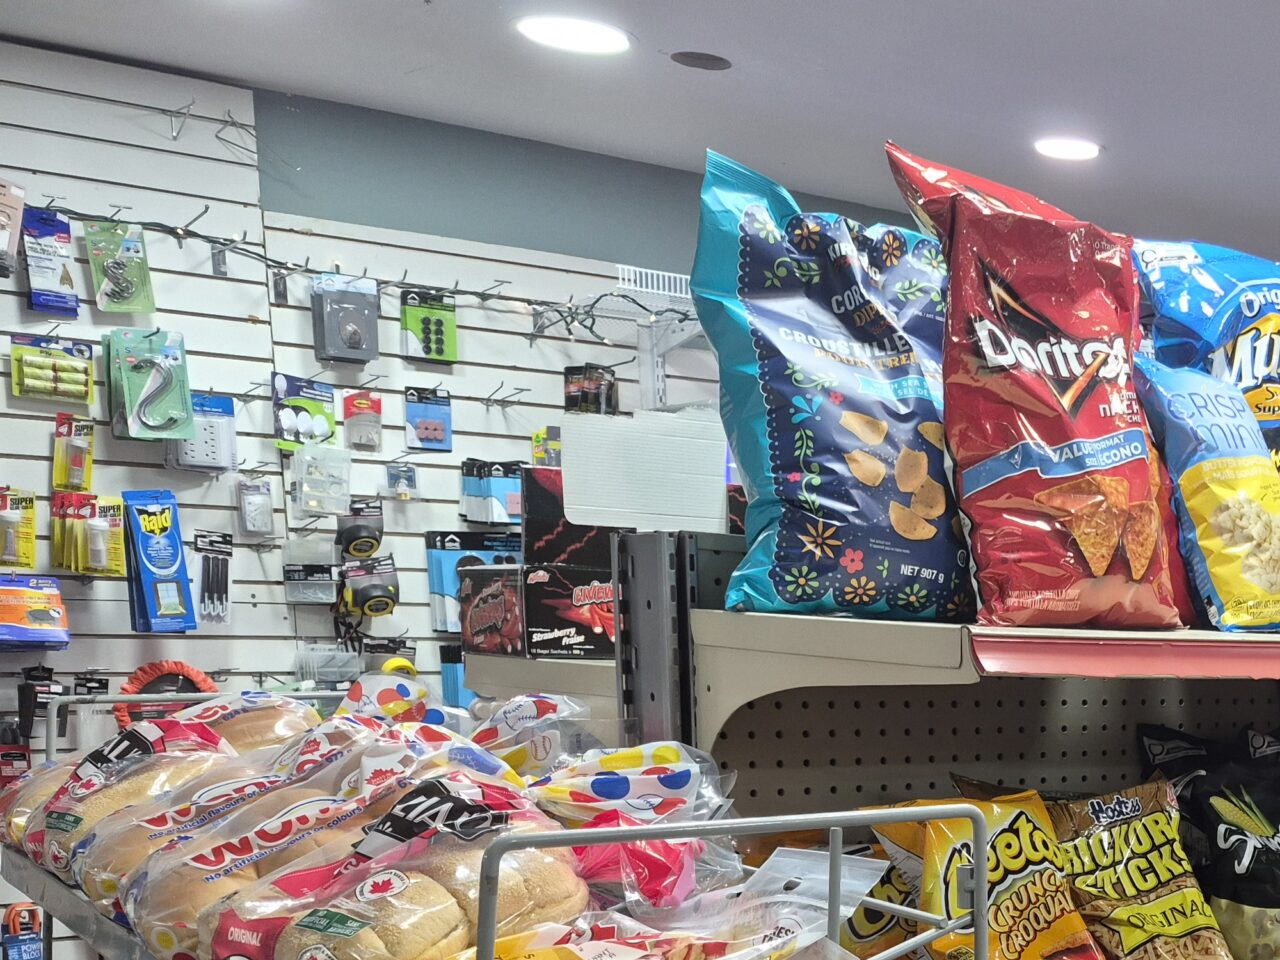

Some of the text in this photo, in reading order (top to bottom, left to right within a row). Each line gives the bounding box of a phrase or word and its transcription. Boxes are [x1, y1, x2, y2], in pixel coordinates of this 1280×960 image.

[74, 424, 94, 434] SUPER
[9, 497, 34, 507] SUPER
[98, 504, 121, 515] SUPER
[139, 508, 172, 533] Raid
[901, 565, 919, 578] NET
[921, 567, 938, 580] 907
[532, 628, 576, 643] Strawberry
[562, 634, 586, 646] Fraise
[205, 872, 222, 884] No
[326, 805, 363, 828] colours
[227, 926, 262, 947] ORIGINAL
